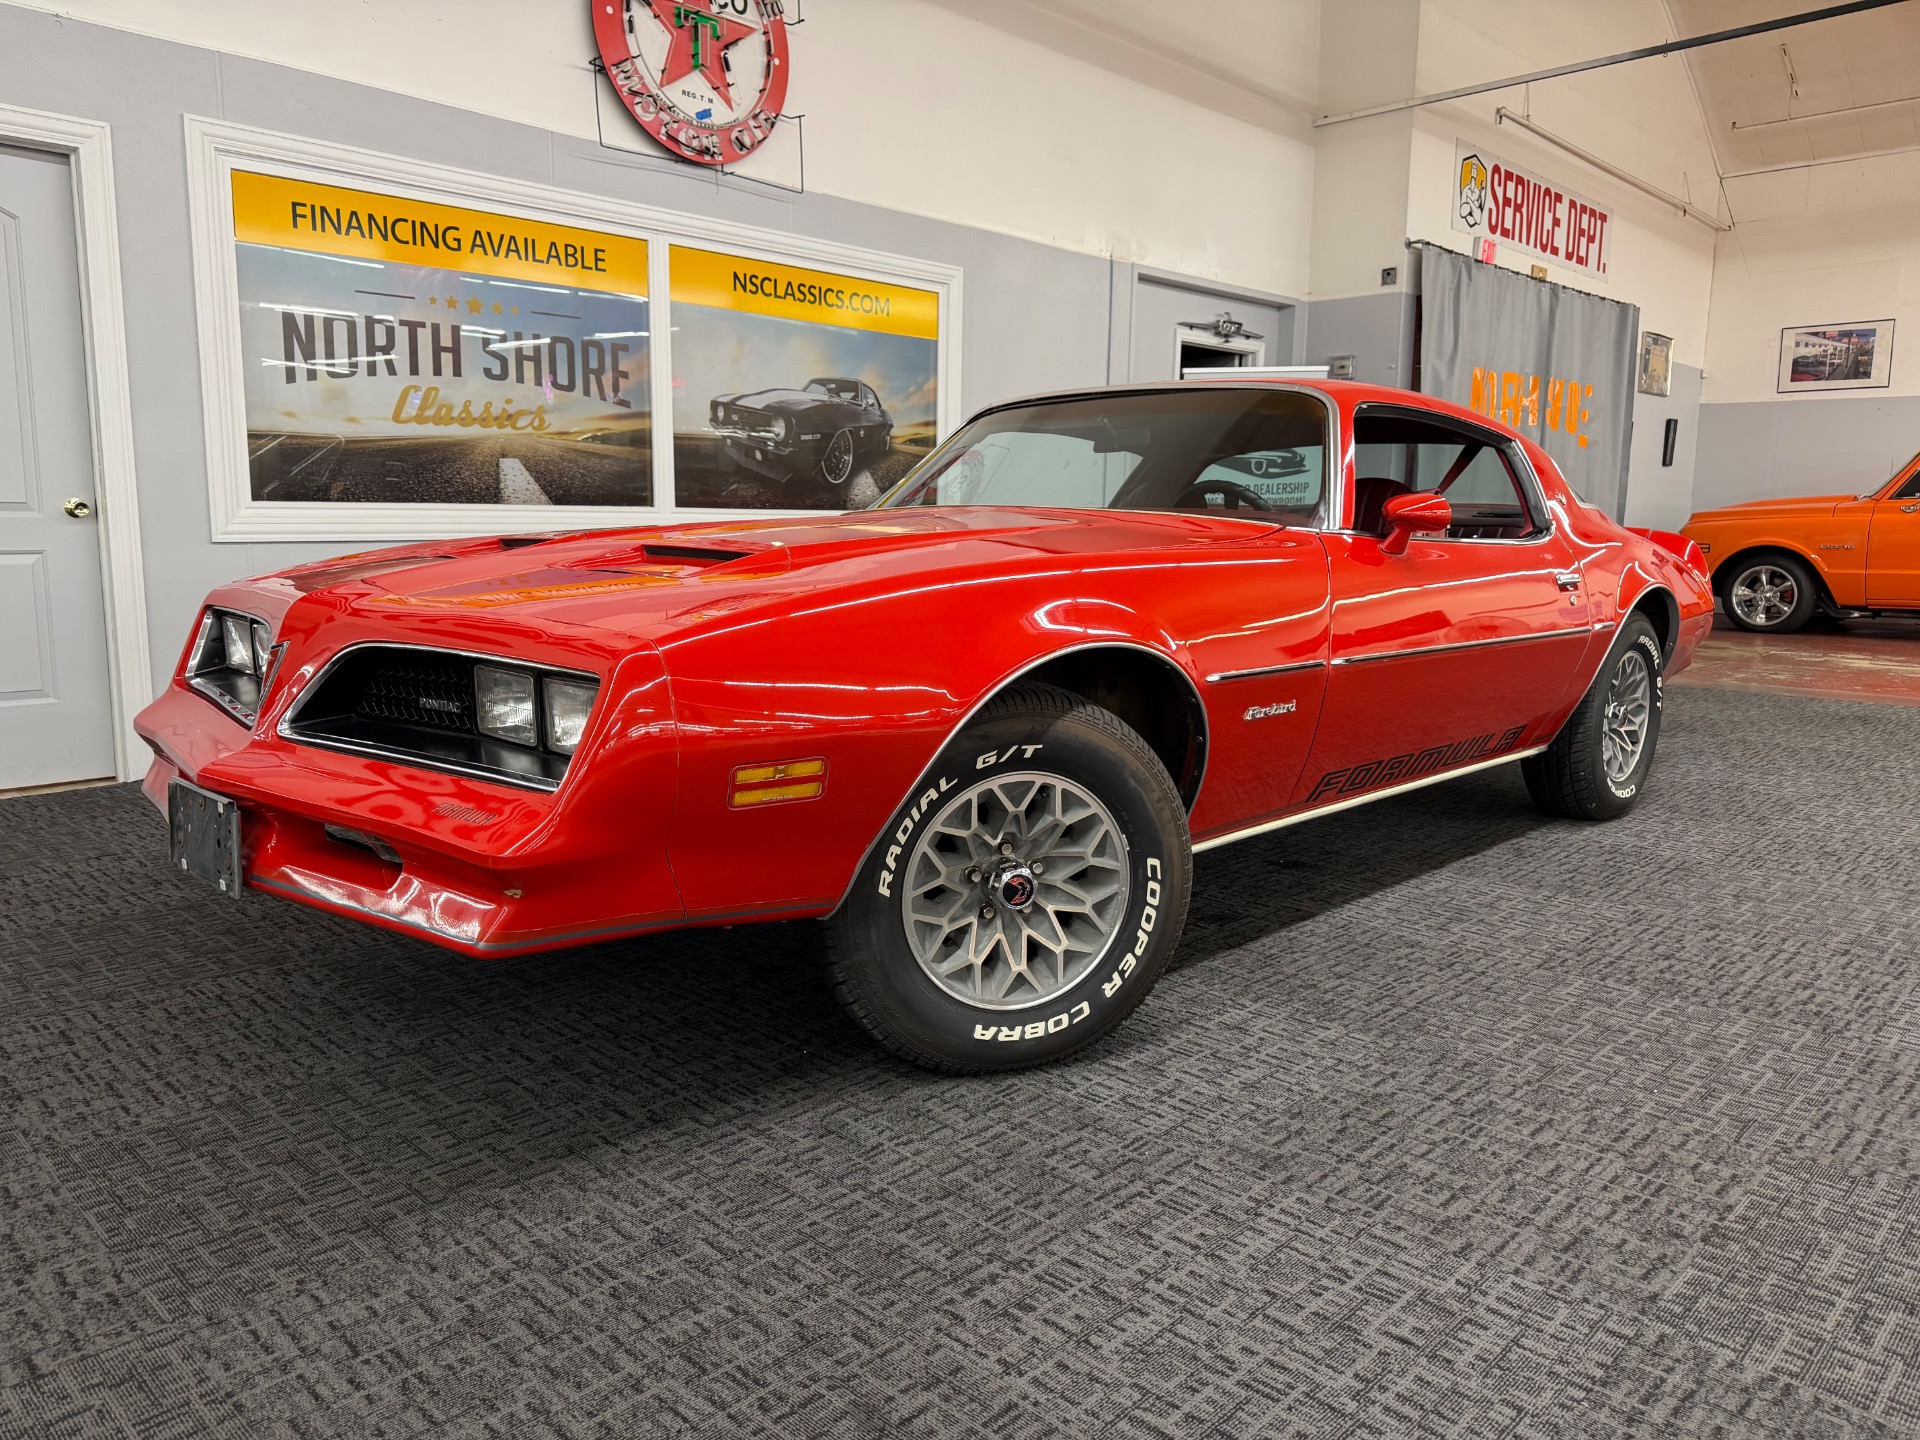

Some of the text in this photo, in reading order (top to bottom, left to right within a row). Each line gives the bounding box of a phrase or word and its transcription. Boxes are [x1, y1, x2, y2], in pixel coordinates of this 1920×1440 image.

[610, 58, 778, 160] MOTOR OIL
[291, 201, 607, 272] FINANCING AVAILABLE
[1487, 164, 1607, 274] SERVICE DEPT.
[733, 271, 890, 317] NSCLASSICS.COM
[281, 309, 632, 409] NORTH SHORE
[391, 384, 552, 432] Classics
[1254, 482, 1310, 495] DEALERSHIP
[1265, 496, 1305, 505] OWROOM!
[1638, 635, 1659, 670] RADIAL
[420, 698, 461, 713] PONTIAC
[1242, 699, 1296, 720] Firebird
[1305, 724, 1527, 802] FORMULA
[1607, 776, 1635, 798] COOPER
[430, 802, 497, 825] FORMULA
[878, 744, 1043, 897] RADIAL G/T
[973, 857, 1161, 1041] COOPER COBRA
